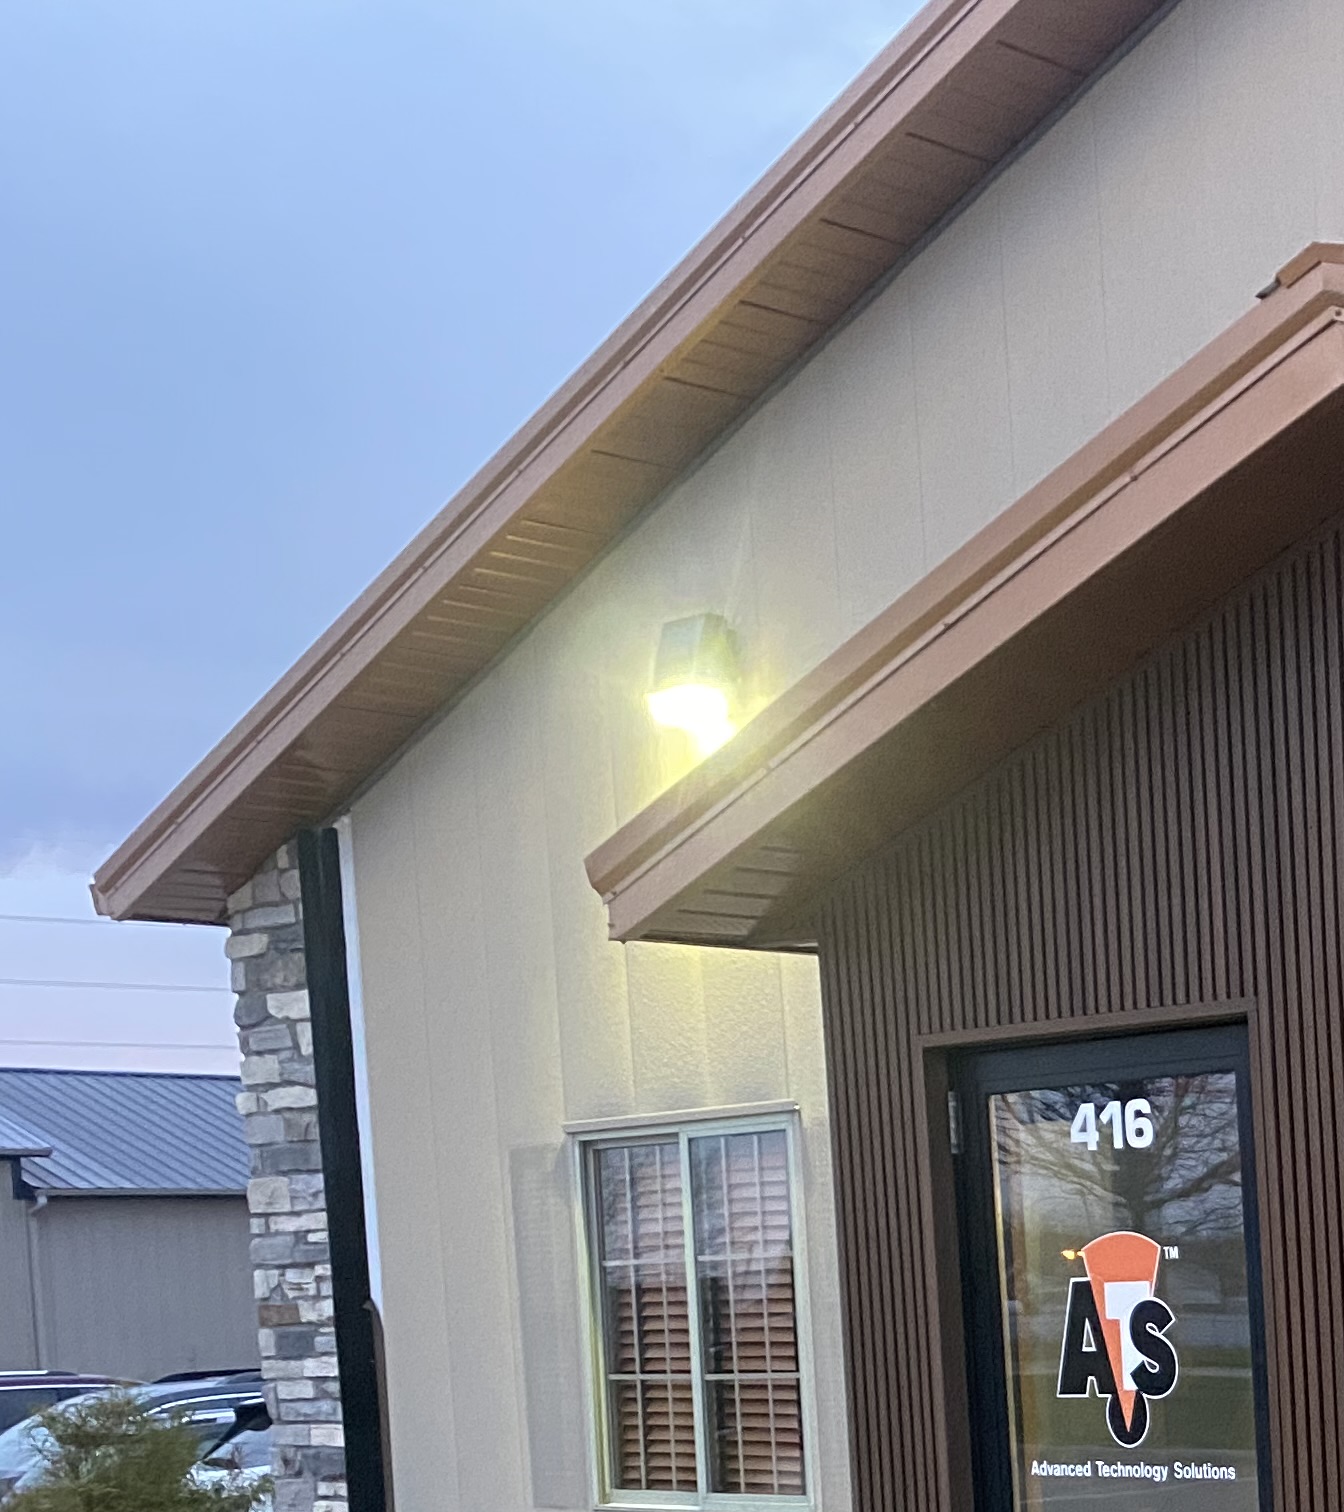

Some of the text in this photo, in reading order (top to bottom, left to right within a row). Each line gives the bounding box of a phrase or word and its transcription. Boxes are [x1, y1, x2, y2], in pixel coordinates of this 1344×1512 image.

[1069, 1098, 1154, 1151] 416
[1163, 1246, 1179, 1259] TM
[1031, 1460, 1236, 1482] Advanced Technology Solutions
